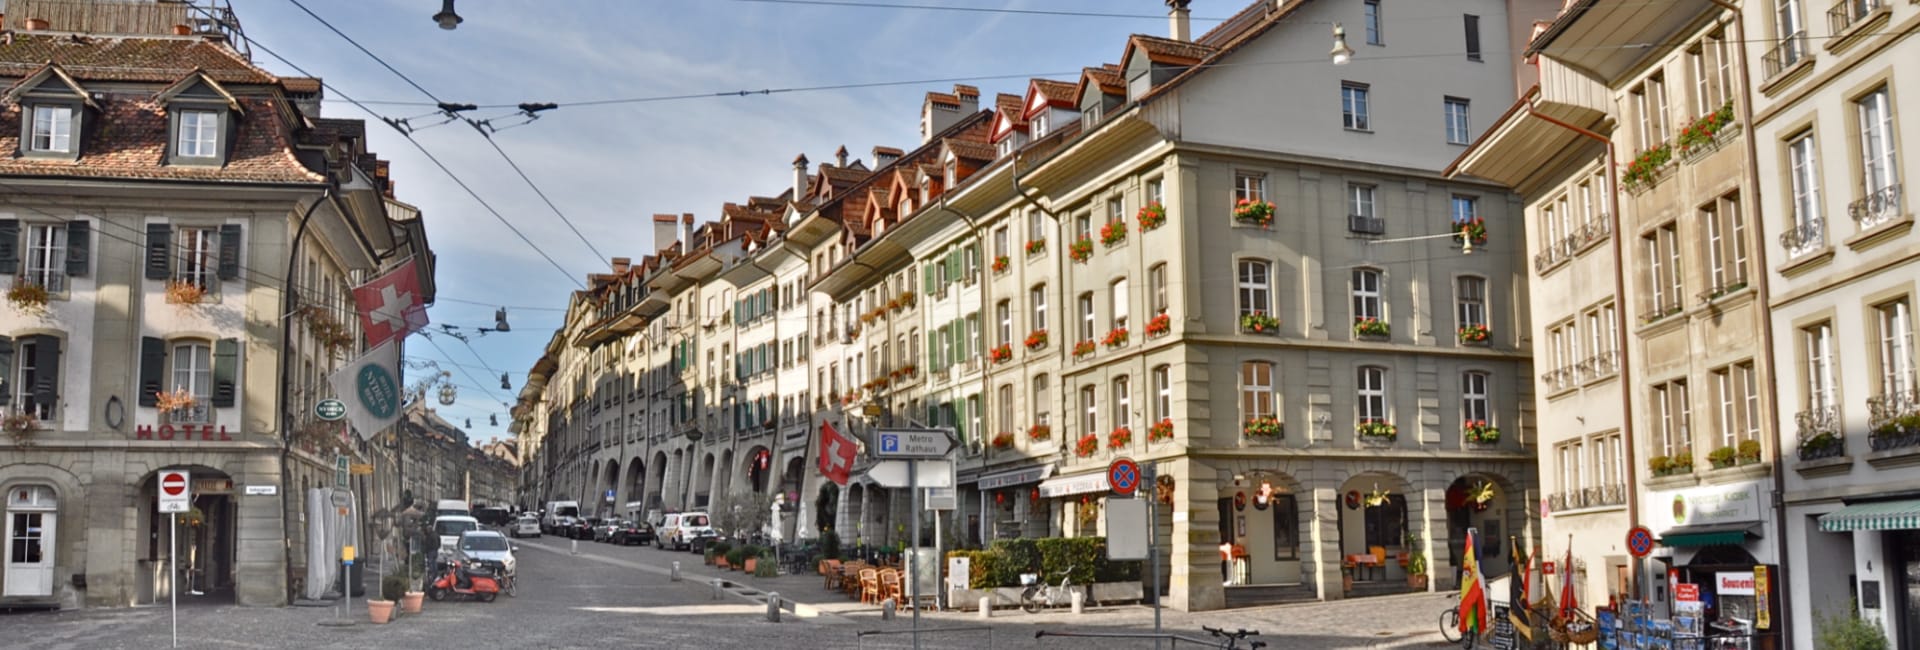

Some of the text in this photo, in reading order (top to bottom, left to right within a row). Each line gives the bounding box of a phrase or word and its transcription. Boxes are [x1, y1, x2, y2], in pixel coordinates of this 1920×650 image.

[365, 370, 389, 414] NYDECK
[137, 424, 232, 441] HOTEL
[909, 434, 933, 443] Metro
[905, 444, 936, 453] Rathaus
[1866, 560, 1873, 573] 4
